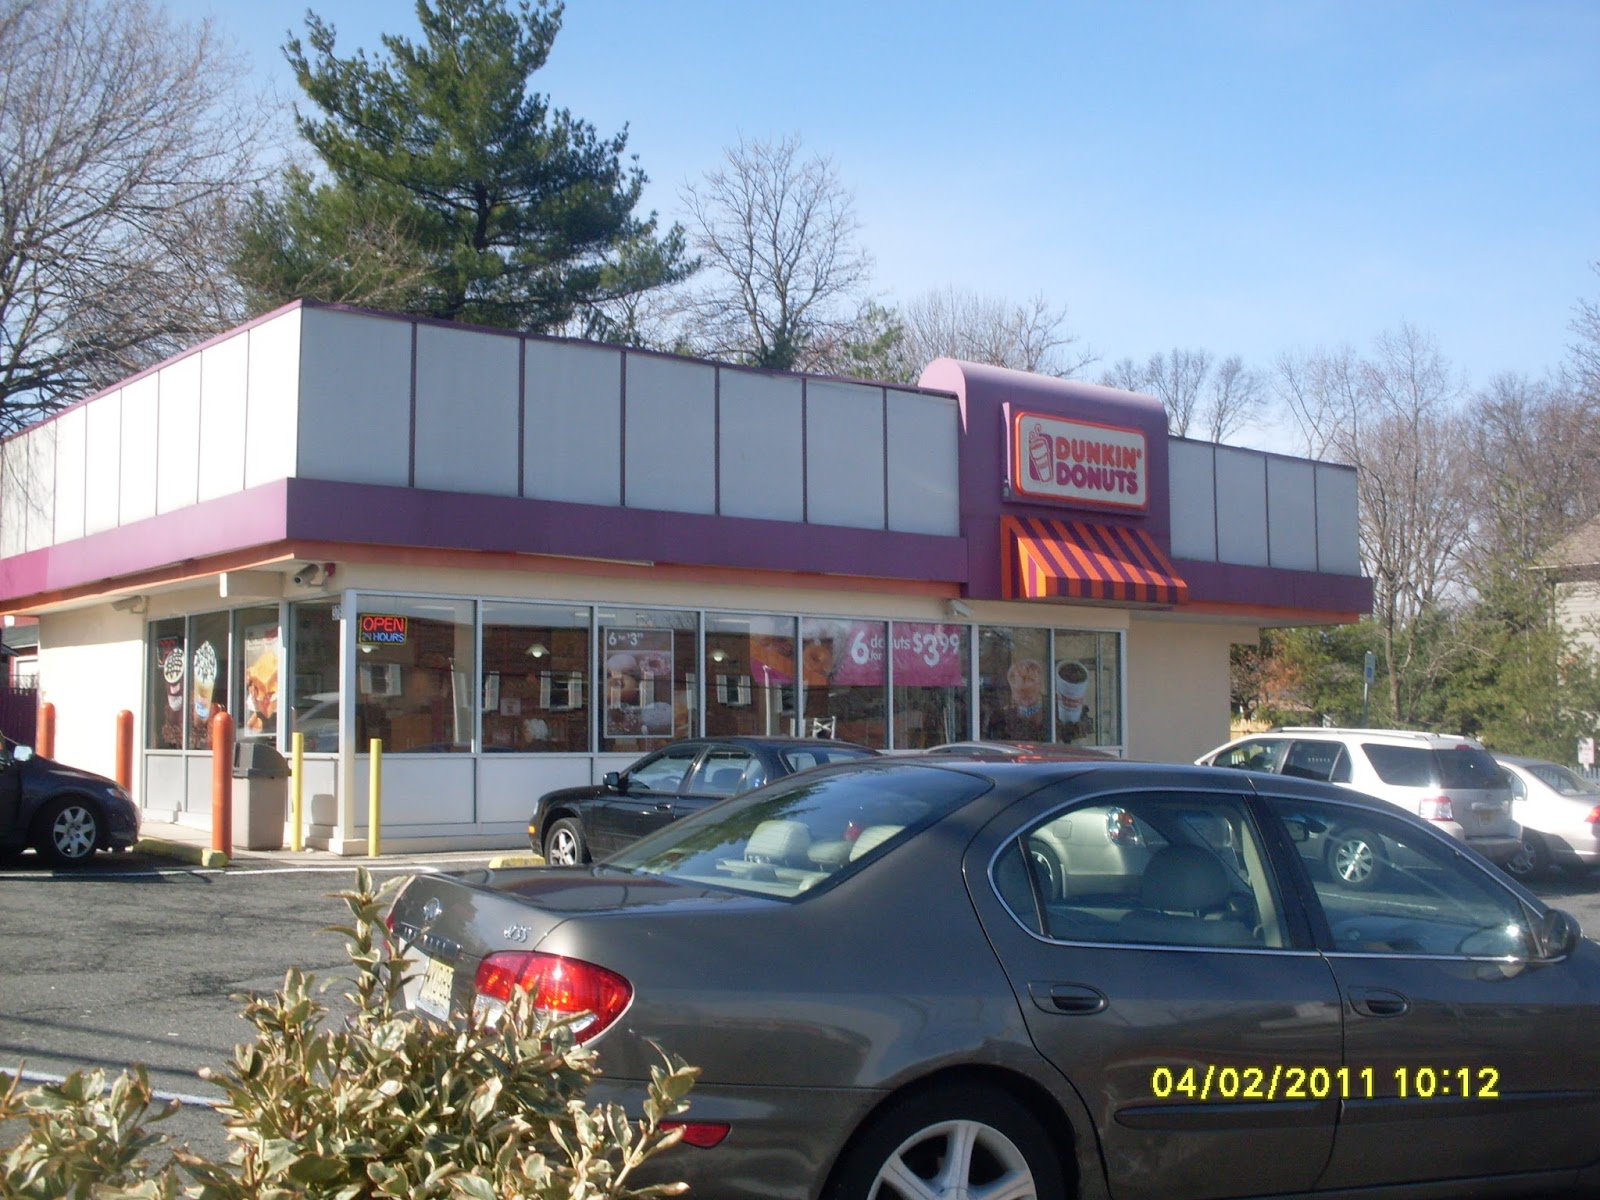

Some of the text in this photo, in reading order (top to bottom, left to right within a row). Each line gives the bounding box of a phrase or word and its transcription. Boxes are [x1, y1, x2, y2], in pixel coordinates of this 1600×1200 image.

[1055, 436, 1142, 470] DUNKIN'
[1055, 462, 1139, 495] DONUTS
[363, 616, 404, 632] OPEN
[373, 632, 405, 643] HOURS
[608, 632, 617, 646] 6
[851, 631, 869, 665] 6
[870, 634, 911, 650] douts
[869, 651, 883, 661] for
